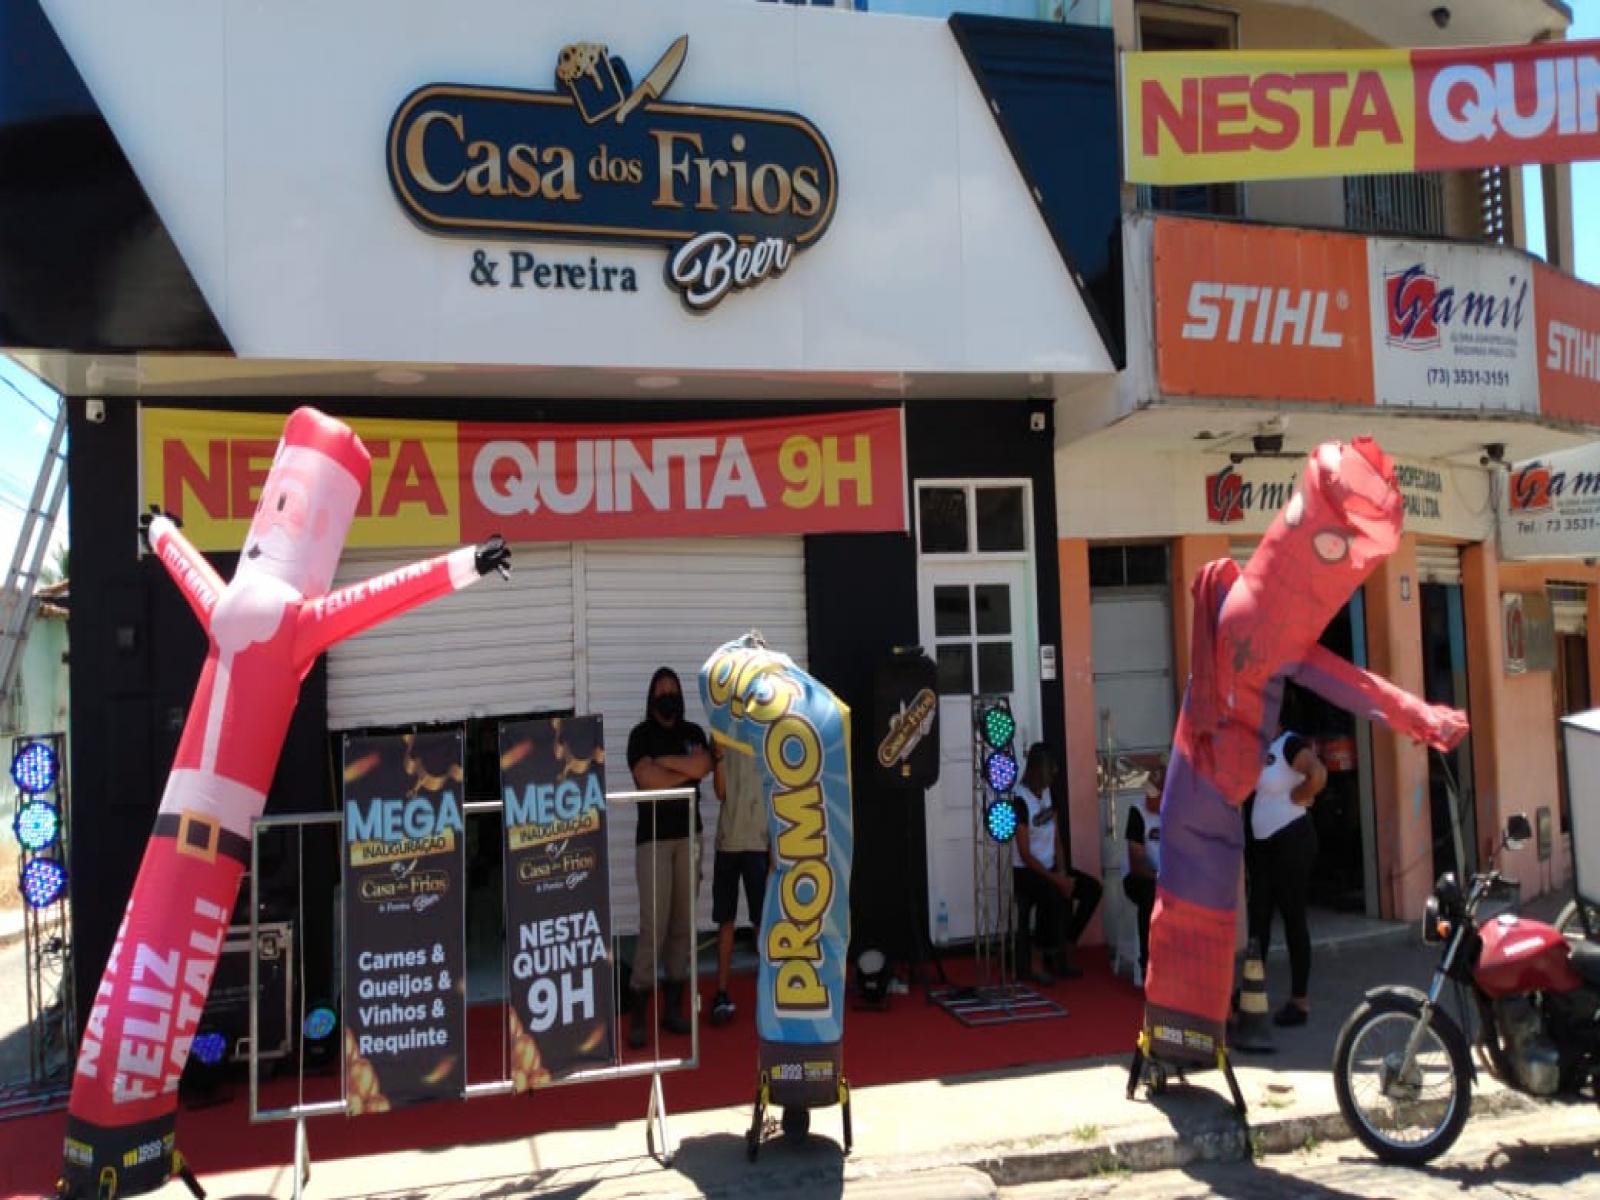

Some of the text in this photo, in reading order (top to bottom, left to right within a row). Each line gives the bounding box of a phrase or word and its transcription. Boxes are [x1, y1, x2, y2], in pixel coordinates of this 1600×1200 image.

[1141, 71, 1404, 157] NESTA
[404, 110, 822, 217] Casa dos Frios
[469, 250, 638, 293] & Pereira
[671, 231, 793, 306] Beer
[1394, 262, 1528, 342] Gamil
[1546, 319, 1600, 382] STIH
[472, 436, 768, 516] QUINTA
[777, 434, 874, 508] 9H
[346, 789, 464, 843] MEGA
[503, 773, 606, 828] MEGA
[359, 943, 446, 972] Carnes &
[519, 910, 601, 950] NESTA
[359, 971, 452, 1000] Queijos &
[512, 936, 609, 980] QUINTA
[112, 942, 181, 1104] FELIZ
[359, 998, 446, 1027] Vinhos &
[527, 967, 595, 1033] 9H
[359, 1028, 449, 1056] Requinte
